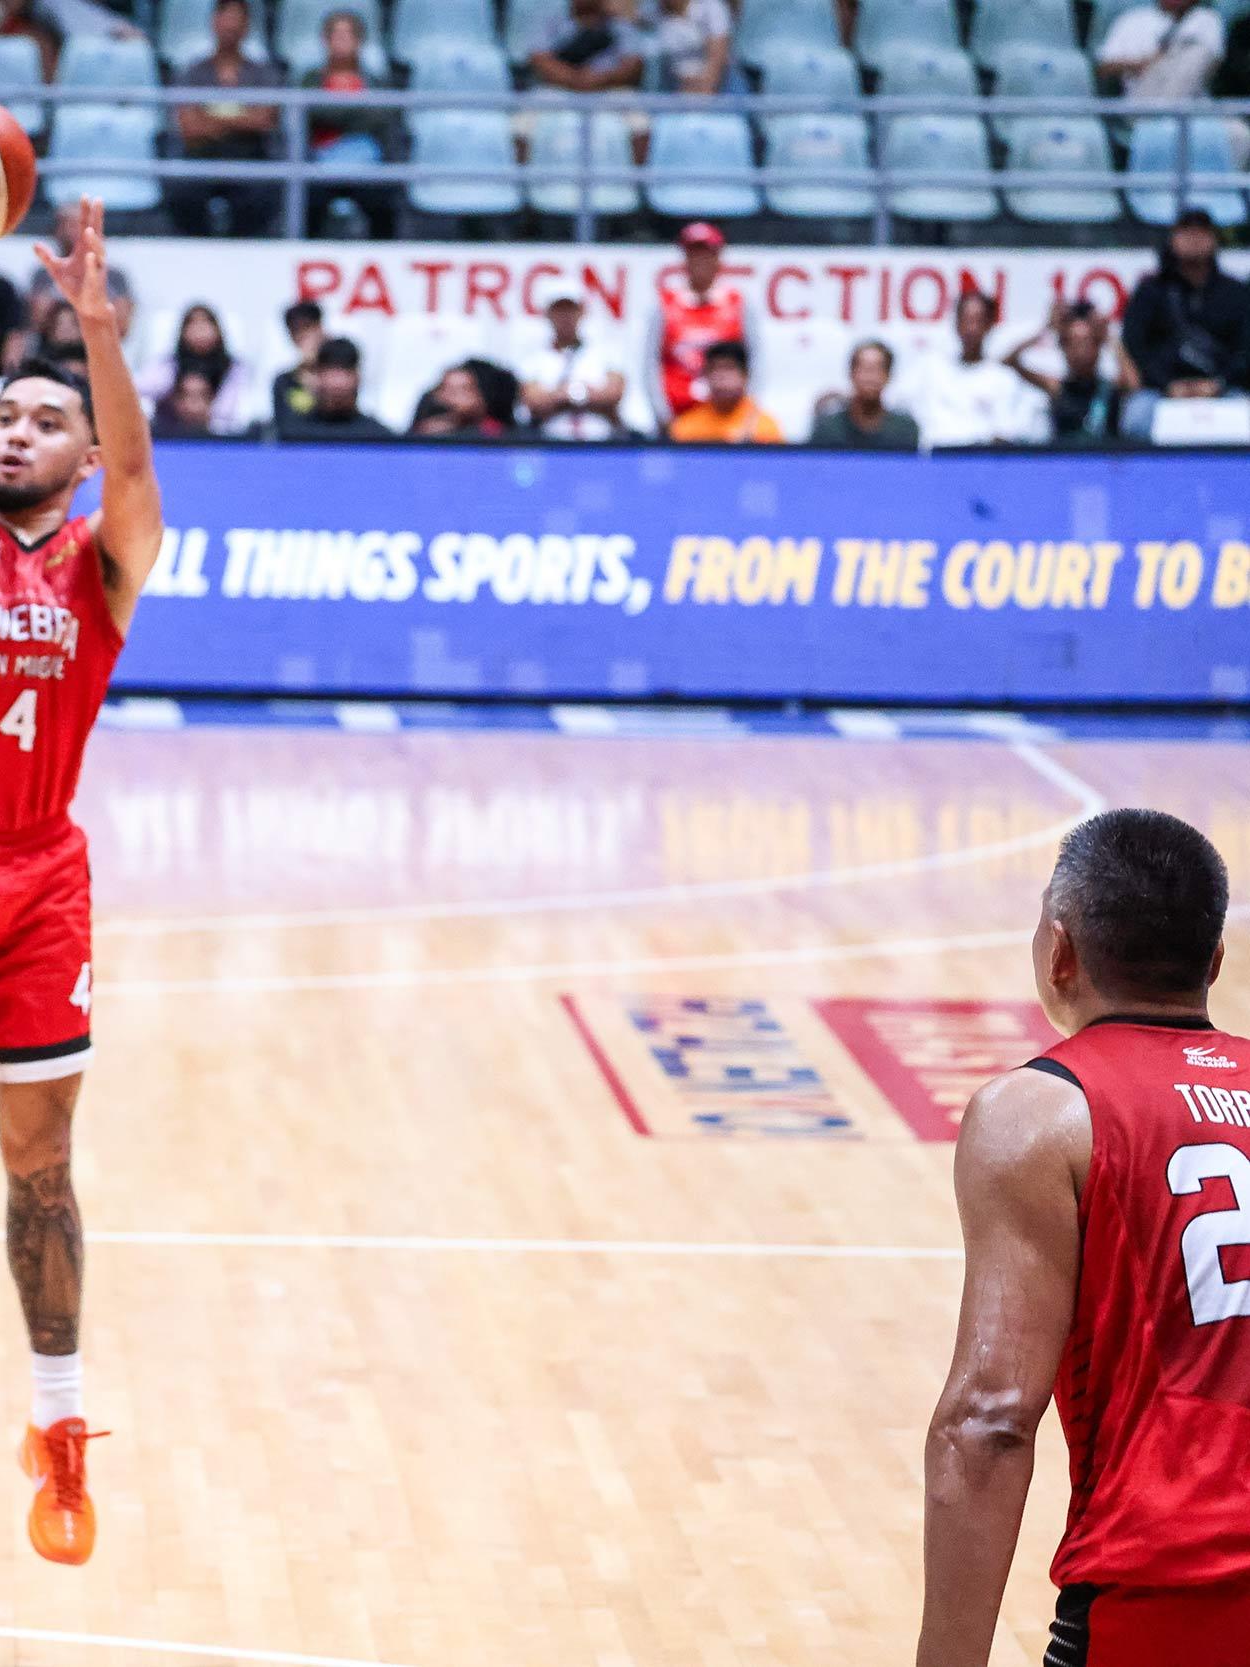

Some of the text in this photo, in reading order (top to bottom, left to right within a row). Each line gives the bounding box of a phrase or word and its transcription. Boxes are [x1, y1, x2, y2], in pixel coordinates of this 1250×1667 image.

[656, 264, 1006, 322] CTION
[141, 527, 210, 598] LL
[221, 528, 424, 602] THINGS
[422, 532, 652, 616] SPORTS,
[664, 535, 823, 607] FROM
[833, 538, 938, 609] THE
[942, 540, 1124, 610] COURT
[1134, 541, 1204, 609] TO
[68, 961, 92, 1016] 4
[1166, 1142, 1250, 1328] 2
